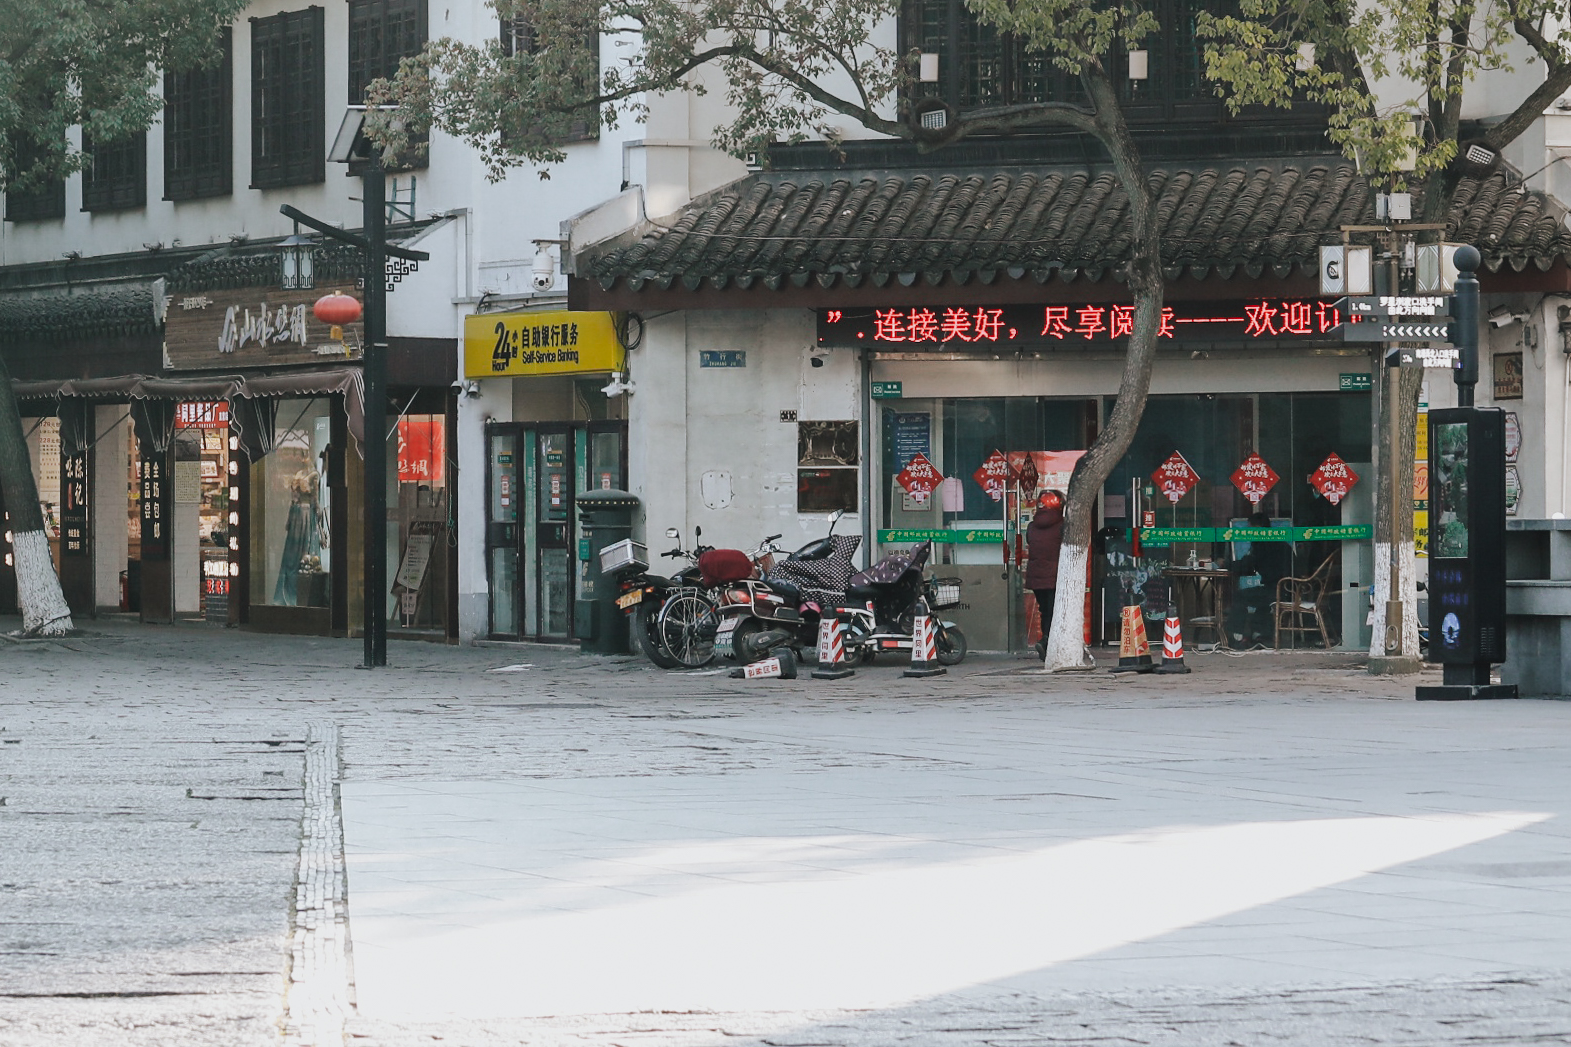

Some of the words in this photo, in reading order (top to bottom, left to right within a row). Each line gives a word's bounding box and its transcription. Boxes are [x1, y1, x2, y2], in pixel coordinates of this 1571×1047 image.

[492, 321, 511, 367] 24
[522, 322, 579, 349] 自助银行服务
[492, 360, 506, 372] Hour
[522, 350, 556, 364] Self-Service
[558, 348, 579, 364] Banking
